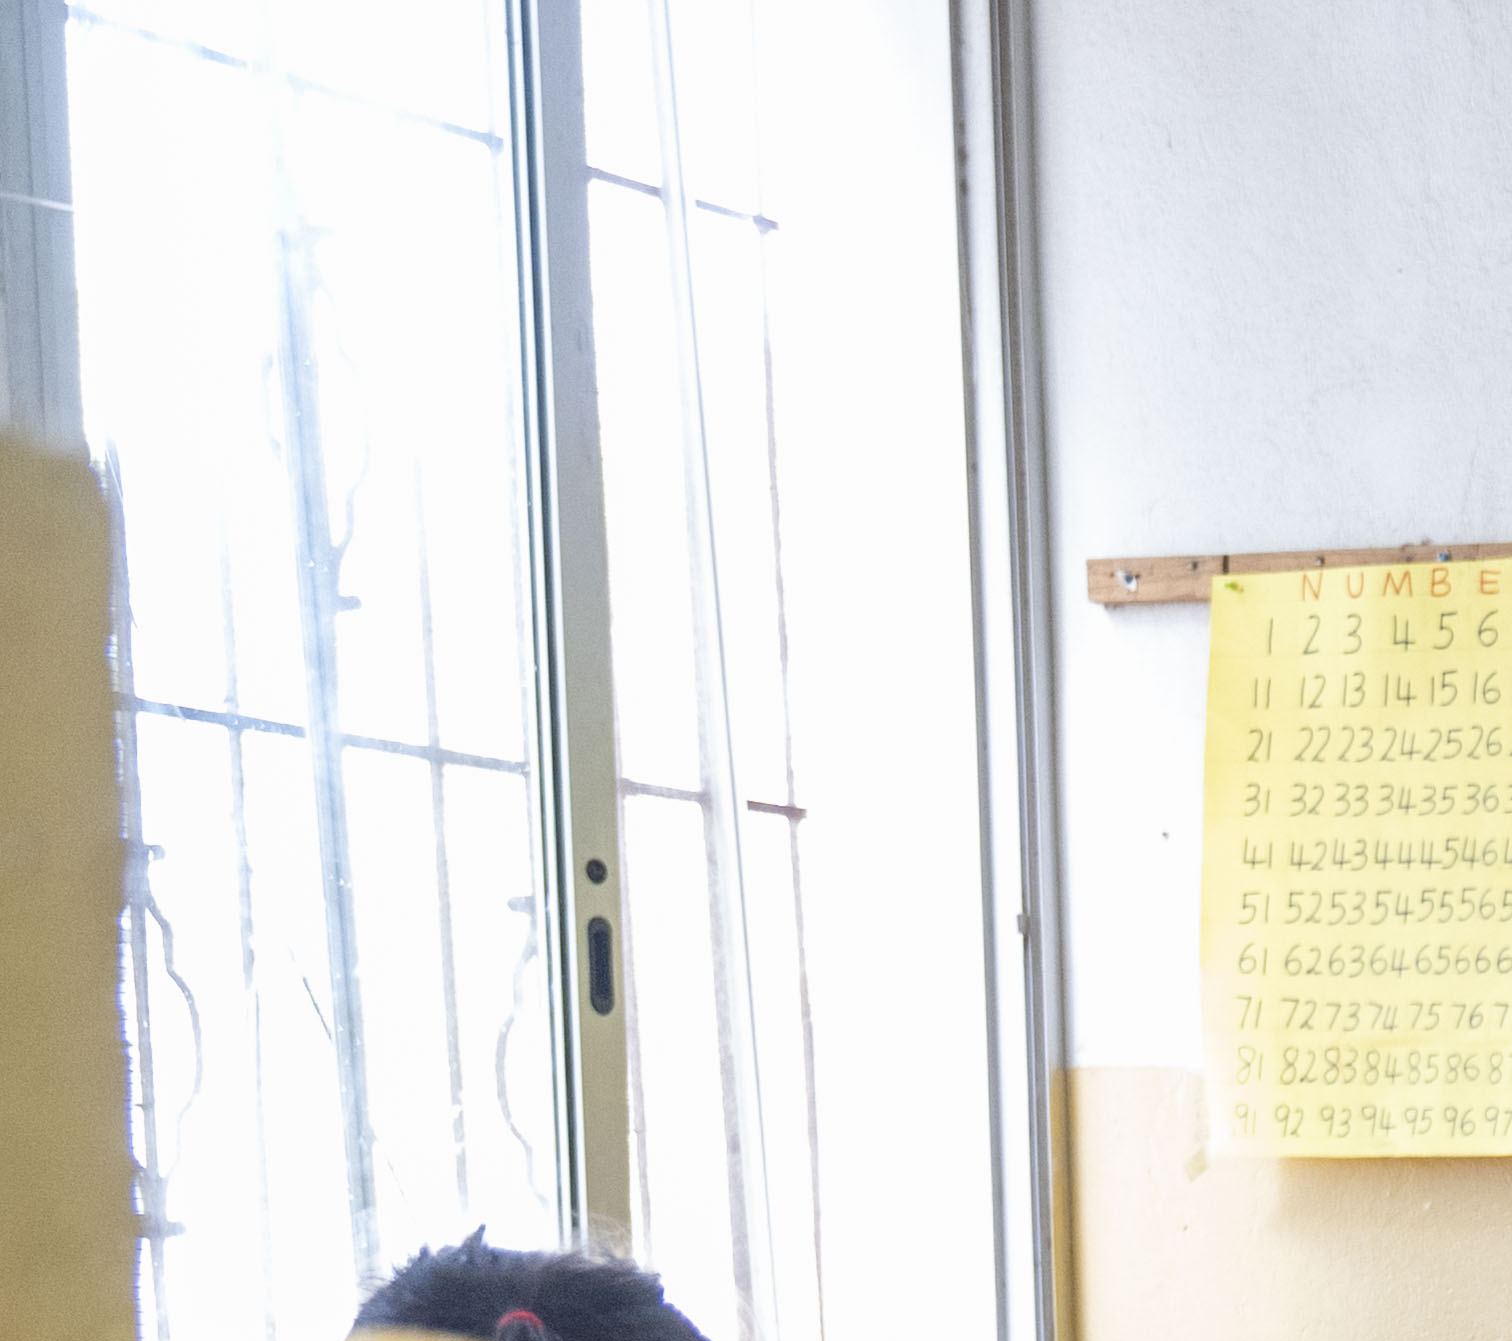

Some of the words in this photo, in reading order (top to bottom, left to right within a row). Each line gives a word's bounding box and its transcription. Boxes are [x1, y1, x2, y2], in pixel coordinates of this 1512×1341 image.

[1266, 618, 1273, 654] 1
[1303, 616, 1320, 655] 2
[1343, 615, 1362, 654] 3
[1393, 616, 1415, 651] 4
[1433, 612, 1457, 649] 5
[1478, 610, 1498, 646] 6
[1253, 678, 1270, 707] 11
[1301, 675, 1325, 709] 12
[1343, 673, 1365, 707] 13
[1383, 675, 1416, 706] 14
[1430, 670, 1458, 706] 15
[1473, 673, 1500, 704] 16
[1247, 730, 1272, 761] 21
[1295, 727, 1332, 761] 22
[1338, 727, 1374, 761] 23
[1380, 729, 1419, 760] 24
[1424, 728, 1462, 760] 25
[1467, 727, 1502, 758] 26
[1245, 784, 1269, 817] 31
[1290, 784, 1324, 817] 32
[1335, 784, 1368, 816] 33
[1376, 784, 1412, 815] 34
[1418, 785, 1457, 814] 35
[1462, 784, 1498, 814] 36
[1243, 838, 1272, 870] 41
[1289, 840, 1327, 871] 42
[1332, 838, 1368, 870] 43
[1374, 839, 1413, 869] 44
[1419, 837, 1461, 869] 45
[1461, 837, 1498, 867] 46
[1239, 892, 1269, 924] 51
[1284, 891, 1323, 924] 52
[1327, 891, 1365, 924] 53
[1370, 891, 1414, 923] 54
[1417, 889, 1455, 923] 55
[1458, 888, 1496, 921] 56
[1239, 944, 1266, 975] 61
[1284, 945, 1321, 975] 62
[1328, 945, 1365, 977] 63
[1369, 945, 1410, 976] 64
[1416, 945, 1452, 975] 65
[1455, 945, 1496, 974] 66
[1235, 997, 1261, 1030] 71
[1281, 998, 1314, 1030] 72
[1323, 1003, 1359, 1030] 73
[1366, 1003, 1398, 1031] 74
[1409, 1002, 1440, 1030] 75
[1452, 1003, 1484, 1029] 76
[1236, 1047, 1262, 1084] 81
[1280, 1047, 1317, 1085] 82
[1323, 1046, 1360, 1085] 83
[1365, 1048, 1402, 1084] 84
[1407, 1052, 1439, 1084] 85
[1445, 1053, 1480, 1084] 86
[1233, 1103, 1256, 1137] 91
[1274, 1105, 1303, 1138] 92
[1320, 1105, 1352, 1138] 93
[1361, 1105, 1395, 1135] 94
[1404, 1105, 1433, 1135] 95
[1443, 1105, 1476, 1136] 96
